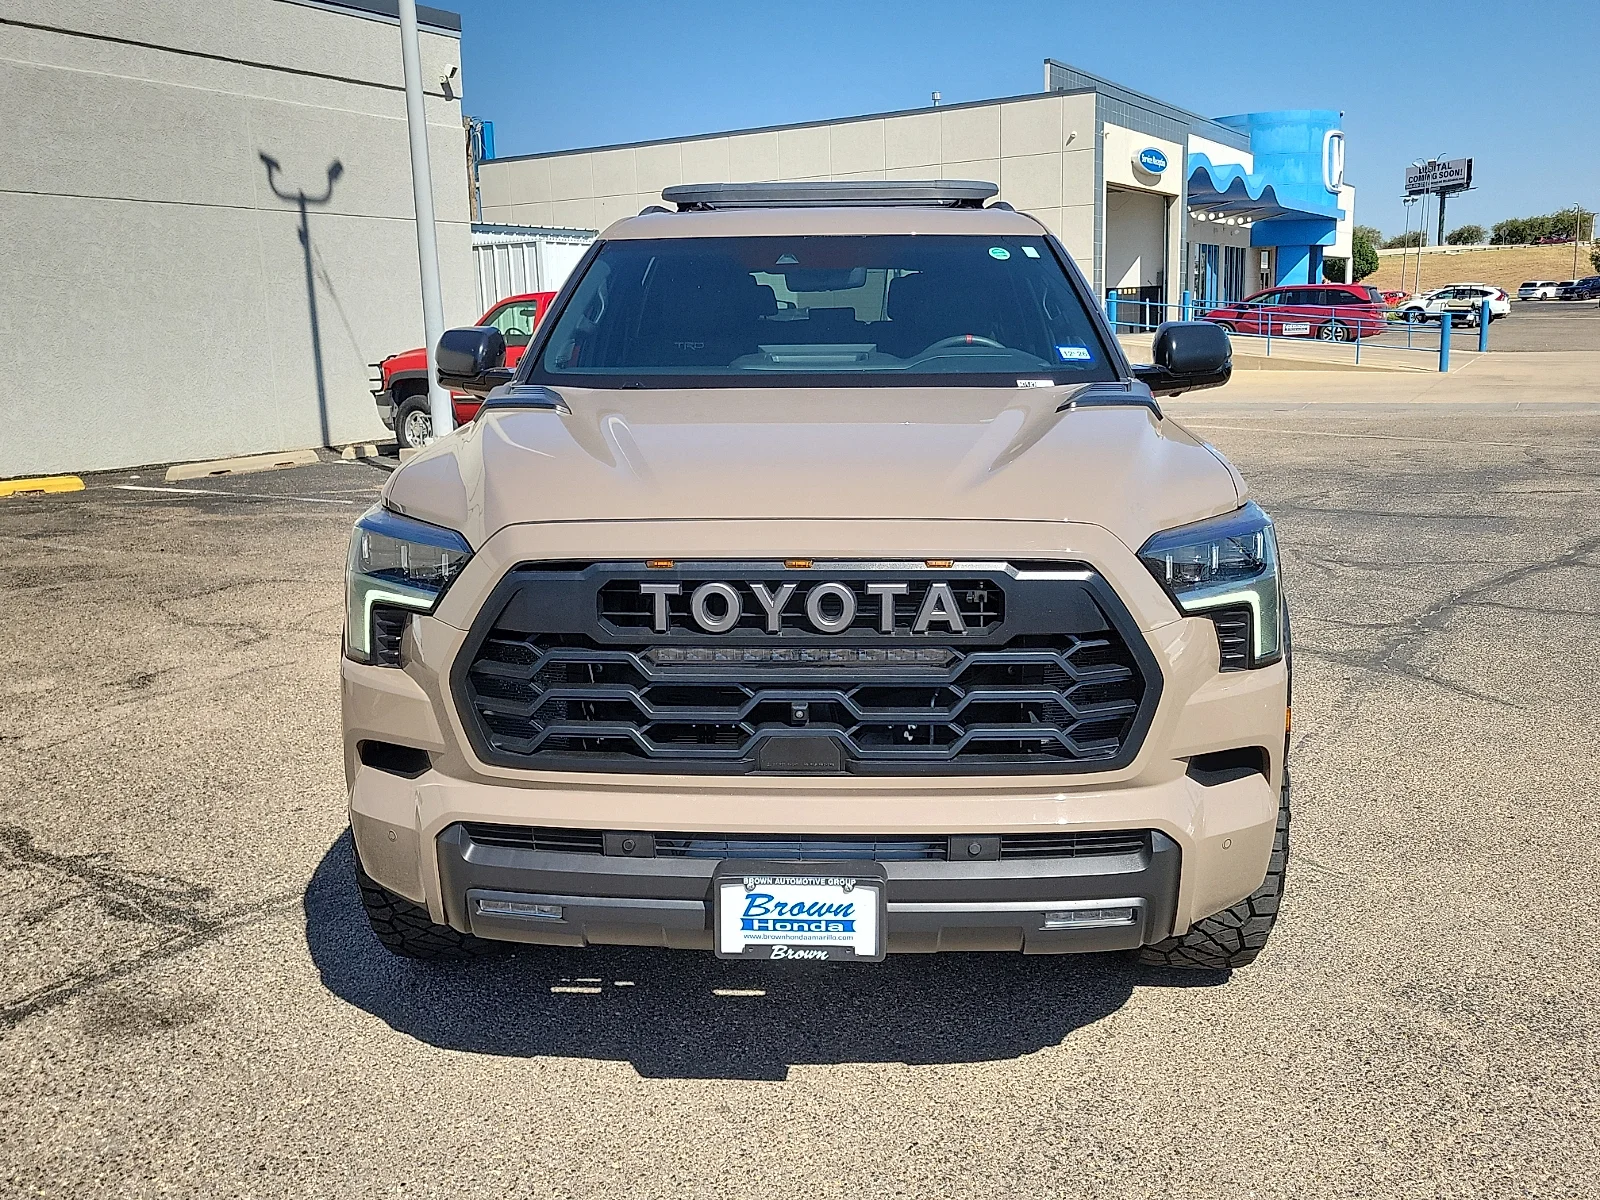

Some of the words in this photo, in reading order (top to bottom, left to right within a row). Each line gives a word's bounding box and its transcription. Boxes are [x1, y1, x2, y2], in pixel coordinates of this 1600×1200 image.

[1438, 168, 1463, 179] SOON!
[674, 342, 704, 350] TRD
[639, 581, 967, 634] TOYOTA
[743, 877, 772, 885] BROWN
[774, 878, 825, 886] AUTOMOTIVE
[827, 878, 856, 886] GROUP
[742, 893, 855, 917] Brown
[753, 919, 844, 932] Honda
[743, 933, 854, 941] www.brownhondaamarillo.com
[770, 944, 829, 960] Brown
